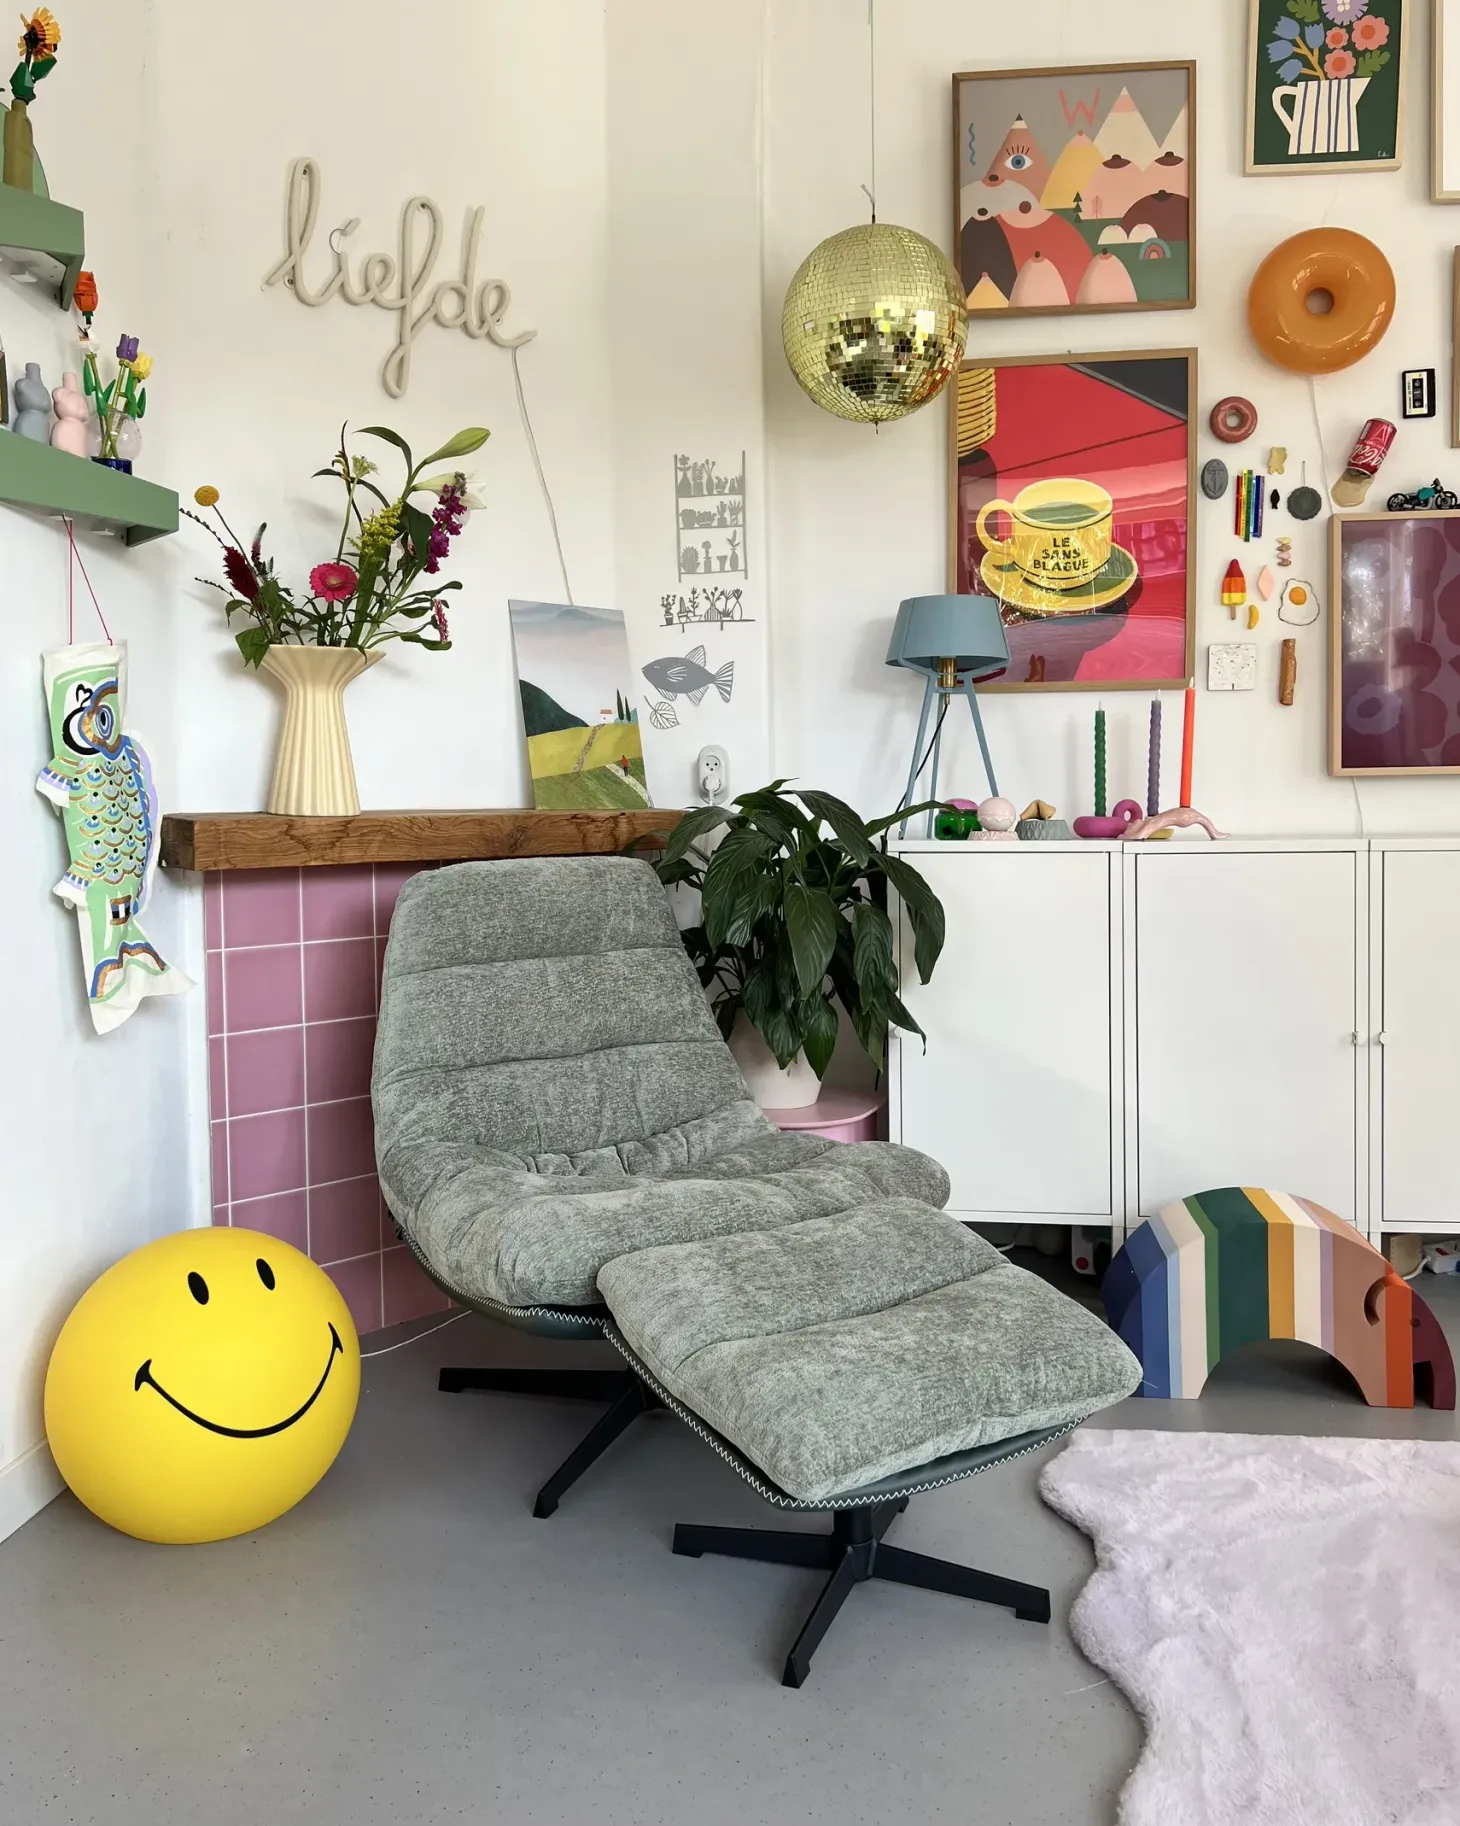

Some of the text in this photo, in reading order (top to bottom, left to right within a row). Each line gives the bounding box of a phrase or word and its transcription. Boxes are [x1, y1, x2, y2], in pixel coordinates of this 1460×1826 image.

[1053, 537, 1070, 548] LE
[1042, 548, 1081, 560] SANS
[1033, 558, 1089, 572] BLAGUE
